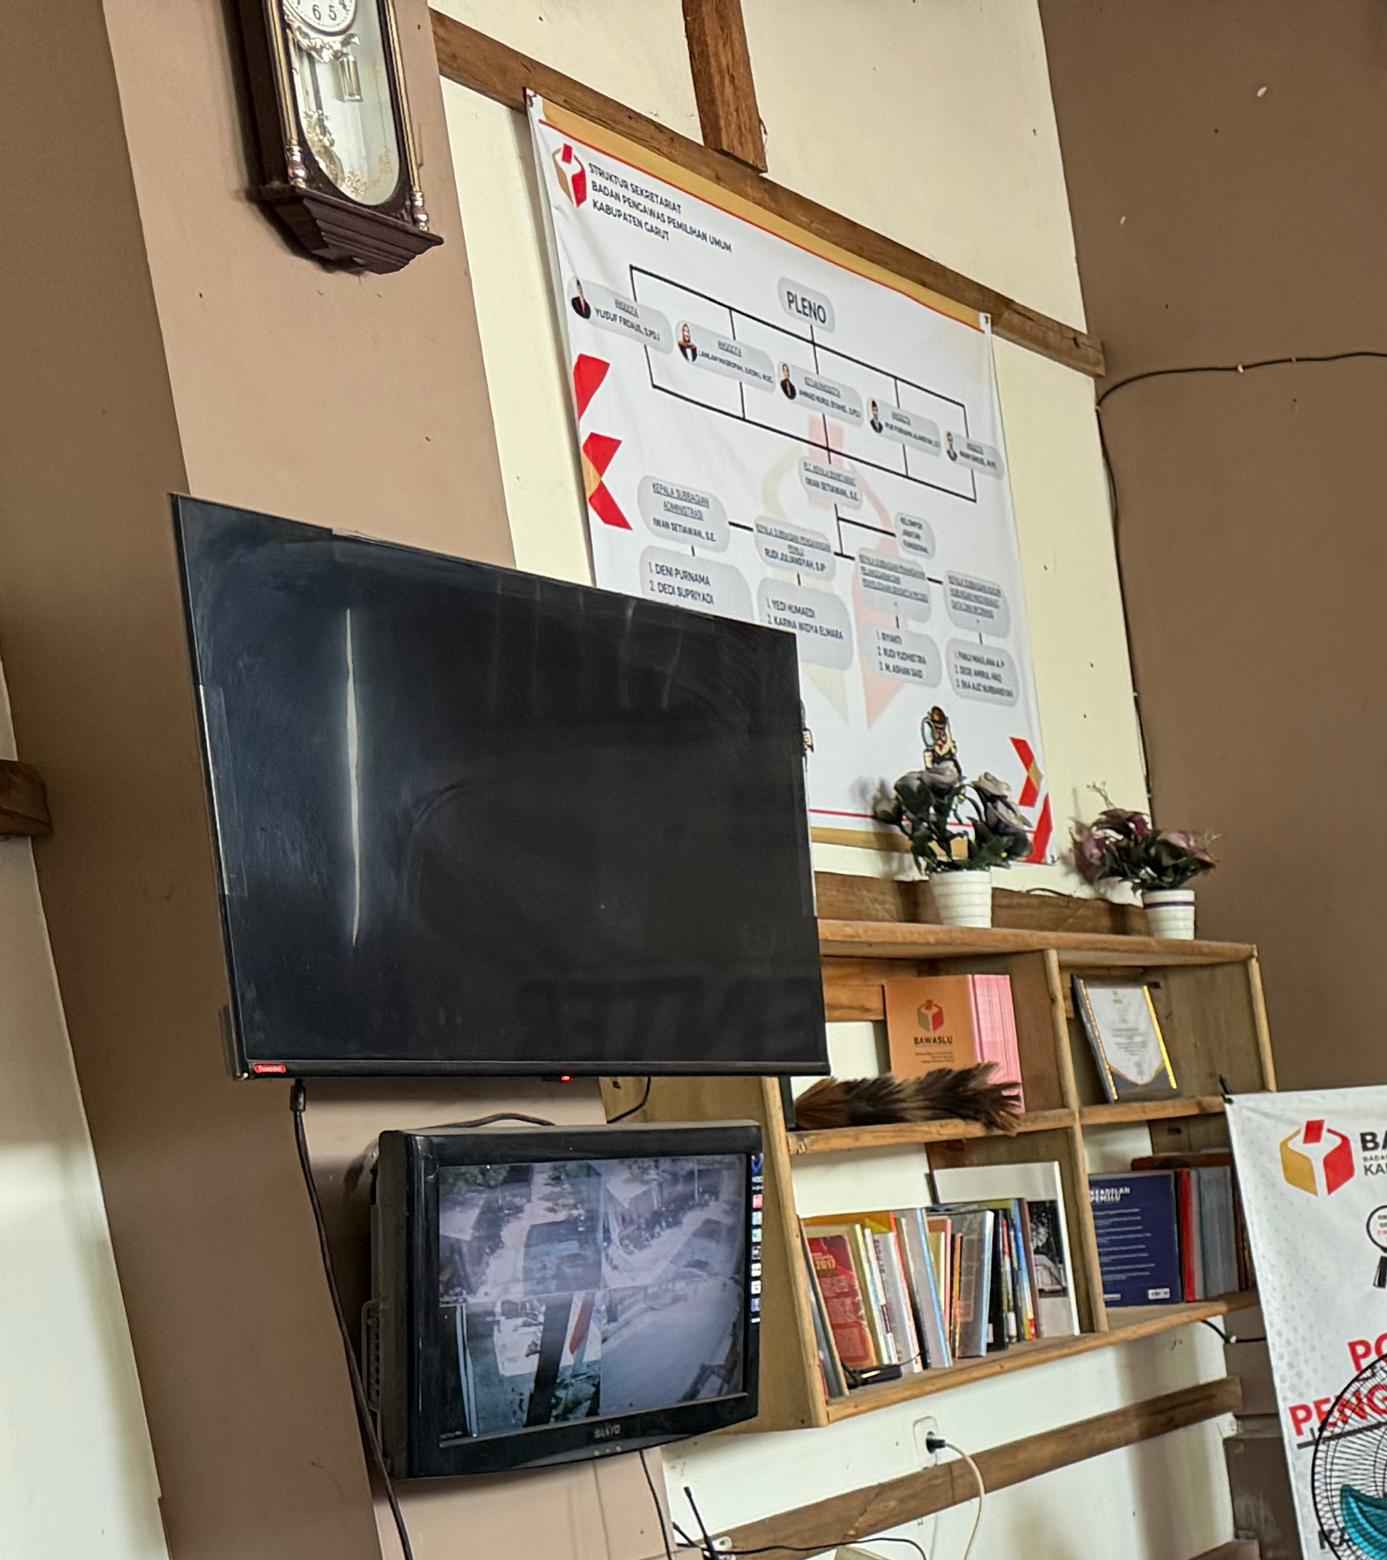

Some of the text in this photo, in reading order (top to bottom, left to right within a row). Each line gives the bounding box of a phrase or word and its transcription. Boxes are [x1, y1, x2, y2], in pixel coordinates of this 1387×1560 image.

[588, 162, 629, 189] STRUKTUR
[591, 179, 622, 203] BADAN
[592, 199, 643, 229] KABUPATEN
[787, 291, 826, 324] PLENO
